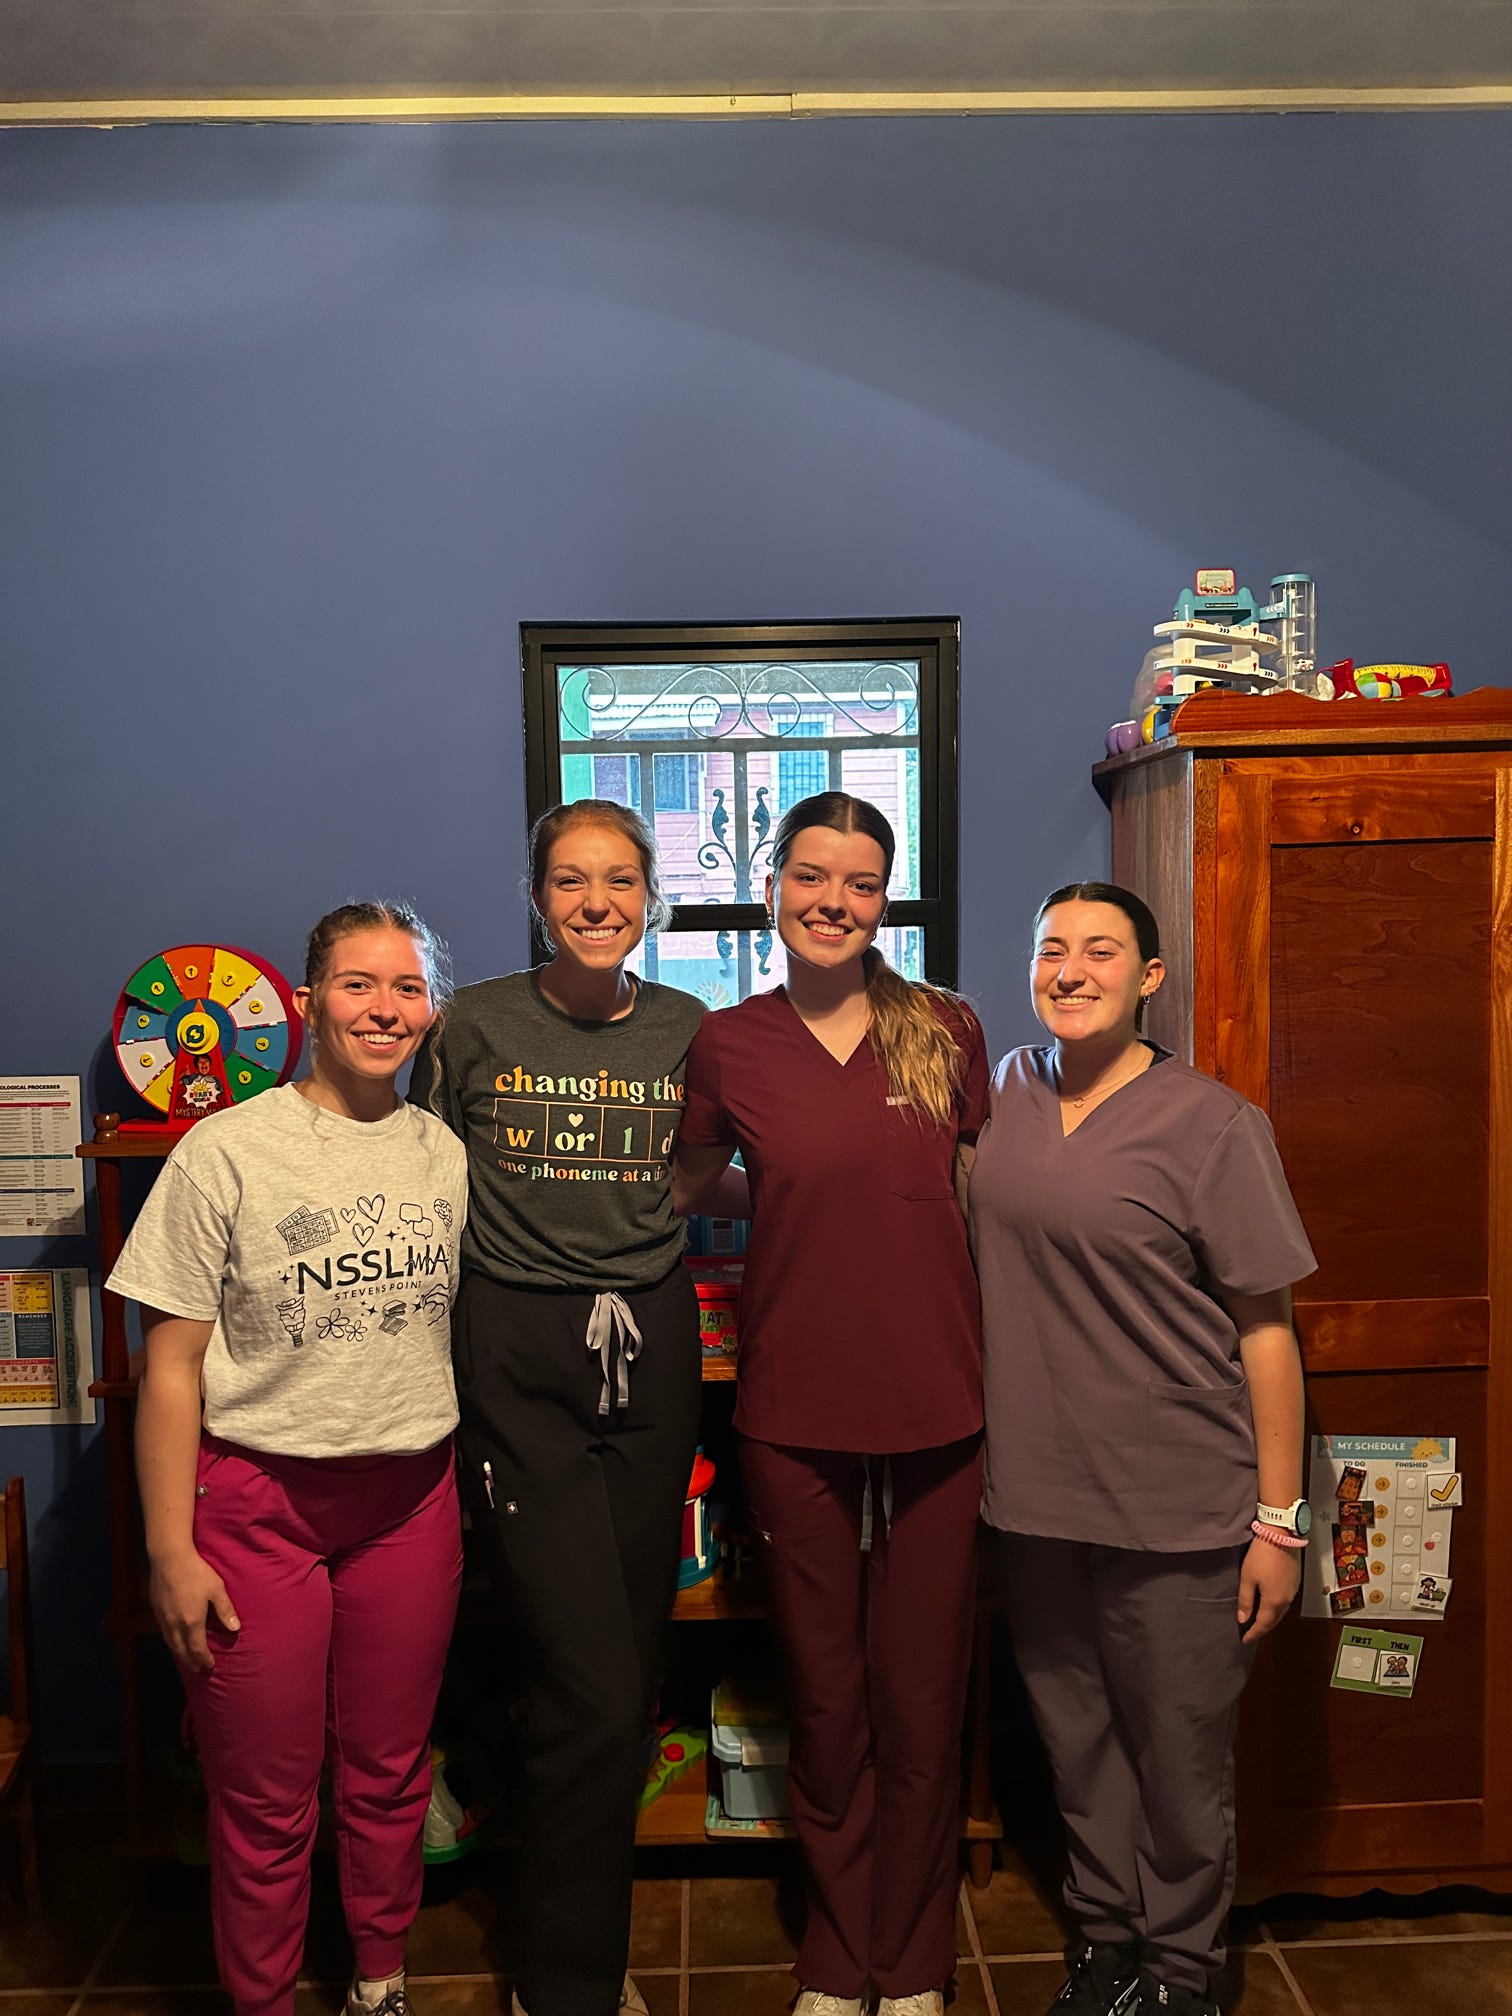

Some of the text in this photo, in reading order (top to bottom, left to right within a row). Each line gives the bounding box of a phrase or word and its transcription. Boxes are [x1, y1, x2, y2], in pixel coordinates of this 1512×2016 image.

[495, 1065, 684, 1104] changing the
[175, 1108, 204, 1116] MYSTERY
[506, 1127, 535, 1148] w
[554, 1131, 595, 1151] or
[661, 1129, 674, 1155] d
[498, 1159, 527, 1174] one
[531, 1162, 618, 1181] phoneme
[622, 1168, 638, 1182] at
[641, 1170, 651, 1181] a
[334, 1280, 423, 1301] STEVENS POINT
[61, 1272, 74, 1333] LANGUAGE
[1337, 1442, 1406, 1451] MY SCHEDULE
[1351, 1635, 1373, 1645] FIRST
[1390, 1641, 1410, 1650] THEN
